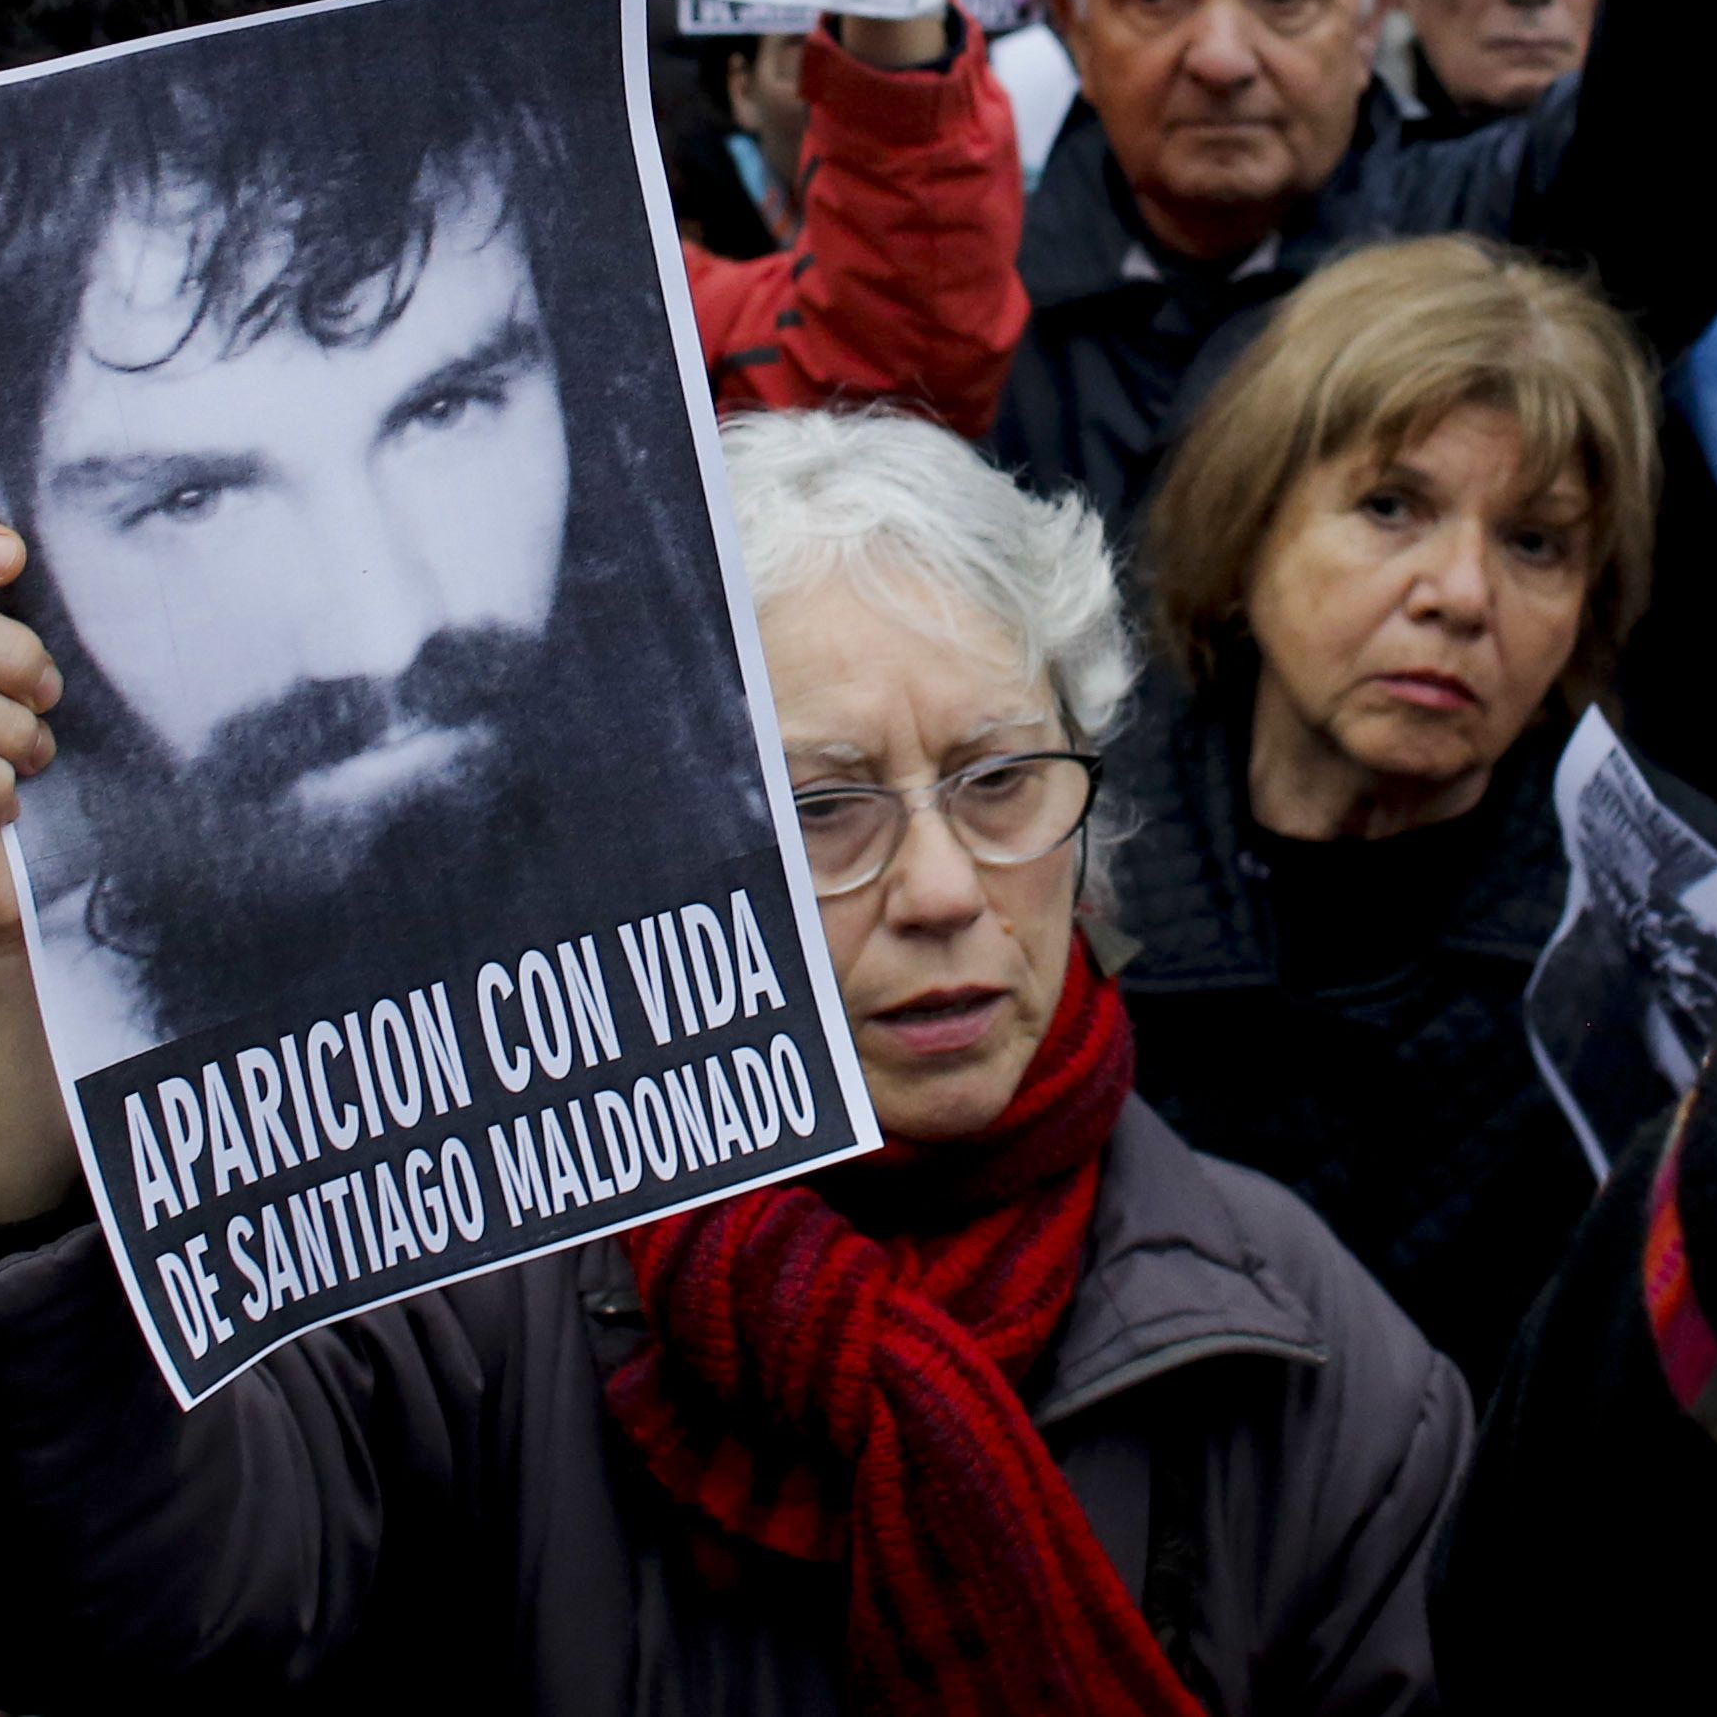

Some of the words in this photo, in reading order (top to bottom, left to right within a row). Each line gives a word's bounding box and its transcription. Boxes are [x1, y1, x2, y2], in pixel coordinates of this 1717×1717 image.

[125, 981, 472, 1231] APARICION
[476, 934, 622, 1092] CON
[618, 889, 786, 1046] VIDA
[155, 1231, 234, 1361] DE
[225, 1136, 484, 1322] SANTIAGO
[488, 1033, 816, 1226] MALDONADO
